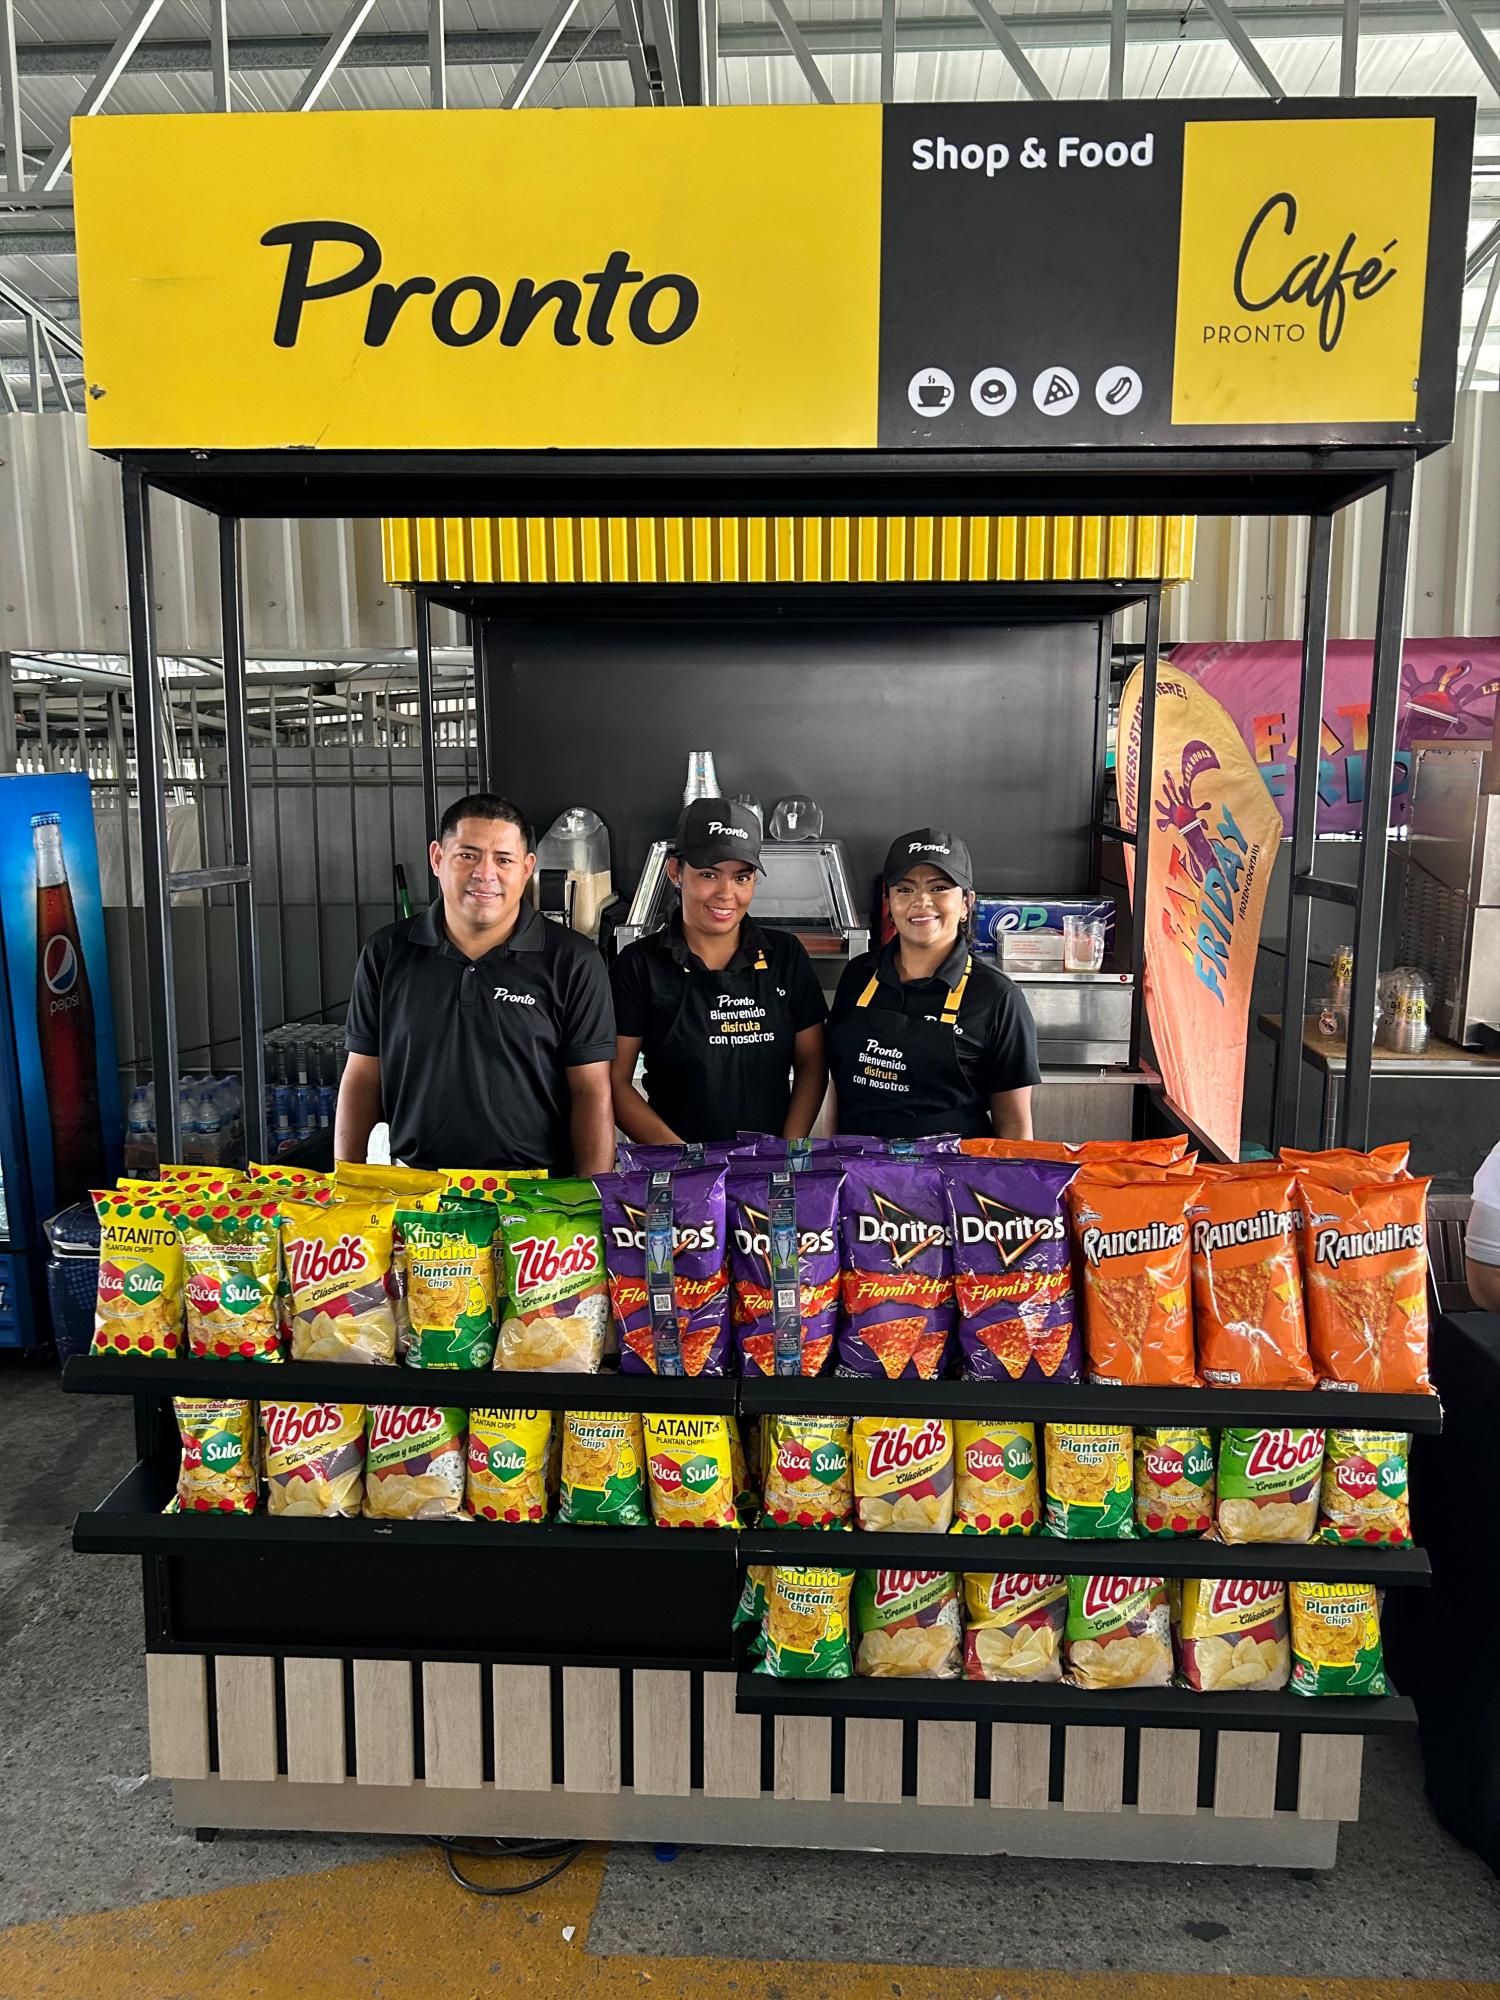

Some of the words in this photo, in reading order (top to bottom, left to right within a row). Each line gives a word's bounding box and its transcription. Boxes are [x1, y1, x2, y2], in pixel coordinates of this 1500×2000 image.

[911, 136, 1010, 177] Shop
[1019, 138, 1048, 169] &
[1058, 133, 1155, 169] Food
[1232, 191, 1398, 353] Café
[259, 219, 700, 348] Pronto
[1202, 323, 1305, 345] PRONTO
[707, 821, 749, 841] Pronto
[908, 842, 951, 855] Pronto
[1239, 884, 1250, 920] FROZEN
[1245, 843, 1260, 887] COCKTAILS
[1194, 802, 1249, 1007] FRIDAY
[49, 993, 81, 1016] pepsi
[493, 987, 537, 1006] Pronto
[717, 994, 756, 1008] Pronto
[709, 1006, 767, 1021] Bienvenido
[720, 1020, 762, 1034] disfruta
[708, 1034, 730, 1046] con
[730, 1031, 775, 1047] nosotros
[866, 1038, 904, 1060] Pronto
[858, 1052, 907, 1072] Bienvenido
[864, 1065, 899, 1081] disfruta
[853, 1074, 867, 1086] con
[868, 1076, 911, 1093] nosotros
[404, 1222, 444, 1249] King
[858, 1215, 953, 1247] Doritos
[961, 1215, 1065, 1244] Doritos
[407, 1244, 477, 1260] Banana
[411, 1263, 472, 1278] Plantain
[128, 1274, 164, 1293] Sula
[311, 1279, 350, 1301] Clásicas
[427, 1278, 453, 1288] Chips
[559, 1277, 592, 1296] especias
[682, 1281, 717, 1297] Hot
[920, 1278, 953, 1295] Hot
[185, 1283, 221, 1302] Rica
[225, 1284, 263, 1303] Sula
[194, 1402, 208, 1410] con
[208, 1412, 224, 1420] pork
[497, 1421, 517, 1430] CHIPS
[778, 1418, 804, 1428] Plantain
[803, 1421, 818, 1429] with
[818, 1421, 834, 1430] pork
[569, 1422, 625, 1438] Plantain
[206, 1441, 242, 1462] Sula
[375, 1452, 400, 1464] Crema
[401, 1449, 407, 1458] y
[408, 1433, 441, 1453] especias
[581, 1438, 606, 1450] Chips
[655, 1437, 685, 1446] PLANTAIN
[686, 1438, 705, 1447] CHIPS
[1060, 1439, 1120, 1454] Plantain
[492, 1451, 527, 1470] Sula
[778, 1451, 812, 1470] Rica
[815, 1453, 847, 1472] Sula
[965, 1450, 1004, 1470] Rica
[1077, 1454, 1103, 1466] Chips
[1145, 1454, 1184, 1474] Rica
[1187, 1453, 1214, 1475] Sula
[650, 1460, 682, 1482] Rica
[686, 1465, 719, 1484] Sula
[895, 1464, 933, 1485] Clásicas
[1333, 1465, 1378, 1486] Rica
[1381, 1466, 1407, 1487] Sula
[1255, 1480, 1288, 1492] Crema
[1288, 1478, 1295, 1488] y
[774, 1569, 840, 1587] Banana
[776, 1584, 834, 1604] Plantain
[884, 1603, 912, 1620] Crema
[912, 1600, 919, 1610] y
[919, 1583, 949, 1605] especias
[790, 1602, 816, 1615] Chips
[1239, 1604, 1276, 1625] Clásicas
[1306, 1600, 1368, 1615] Plantain
[1094, 1614, 1122, 1630] Crema
[1325, 1615, 1352, 1627] Chips
